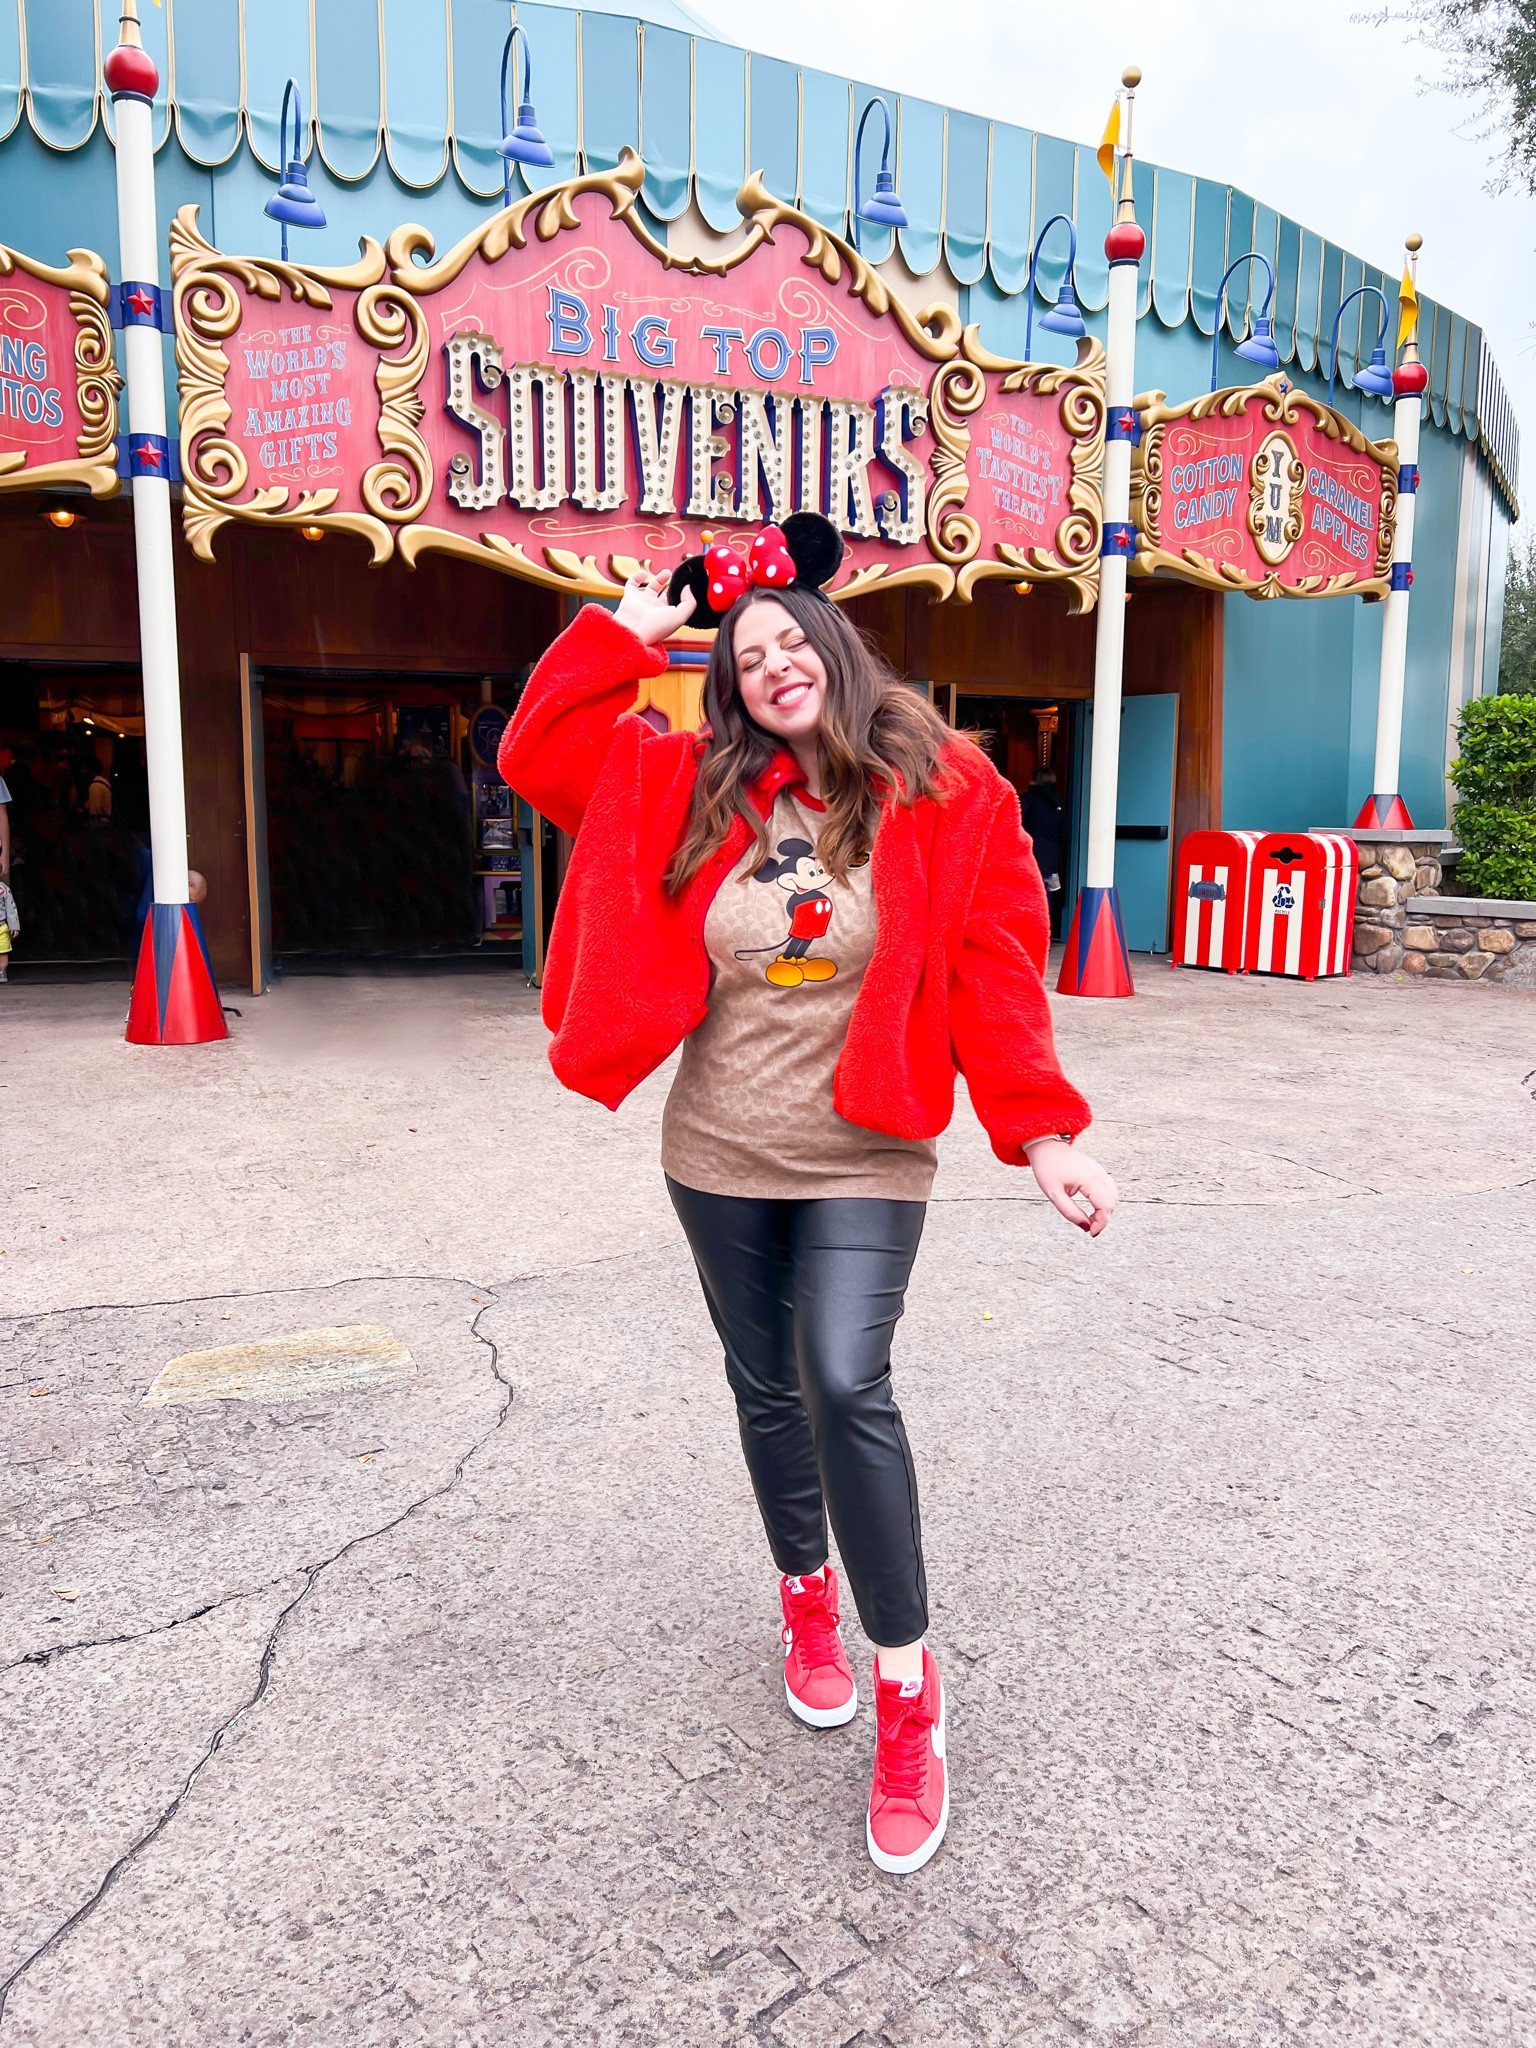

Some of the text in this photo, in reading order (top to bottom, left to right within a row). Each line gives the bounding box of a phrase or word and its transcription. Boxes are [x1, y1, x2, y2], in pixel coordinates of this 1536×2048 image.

[279, 325, 312, 347] THE
[546, 285, 840, 385] BIG TOP
[0, 334, 46, 381] NG
[243, 341, 347, 379] WORLD'S
[270, 373, 331, 403] MOST
[243, 397, 352, 437] AMAZING
[442, 330, 930, 545] SOUVENIRS
[1010, 413, 1034, 439] THE
[259, 431, 338, 469] GIFTS
[990, 426, 1051, 470] WORLD'S
[975, 446, 1063, 506] TASTIEST
[1170, 453, 1244, 495] COTTON
[991, 485, 1046, 526] TREATS
[1174, 487, 1238, 529] CANDY
[1308, 467, 1374, 531] CARAMEL
[1311, 502, 1370, 560] APPLES
